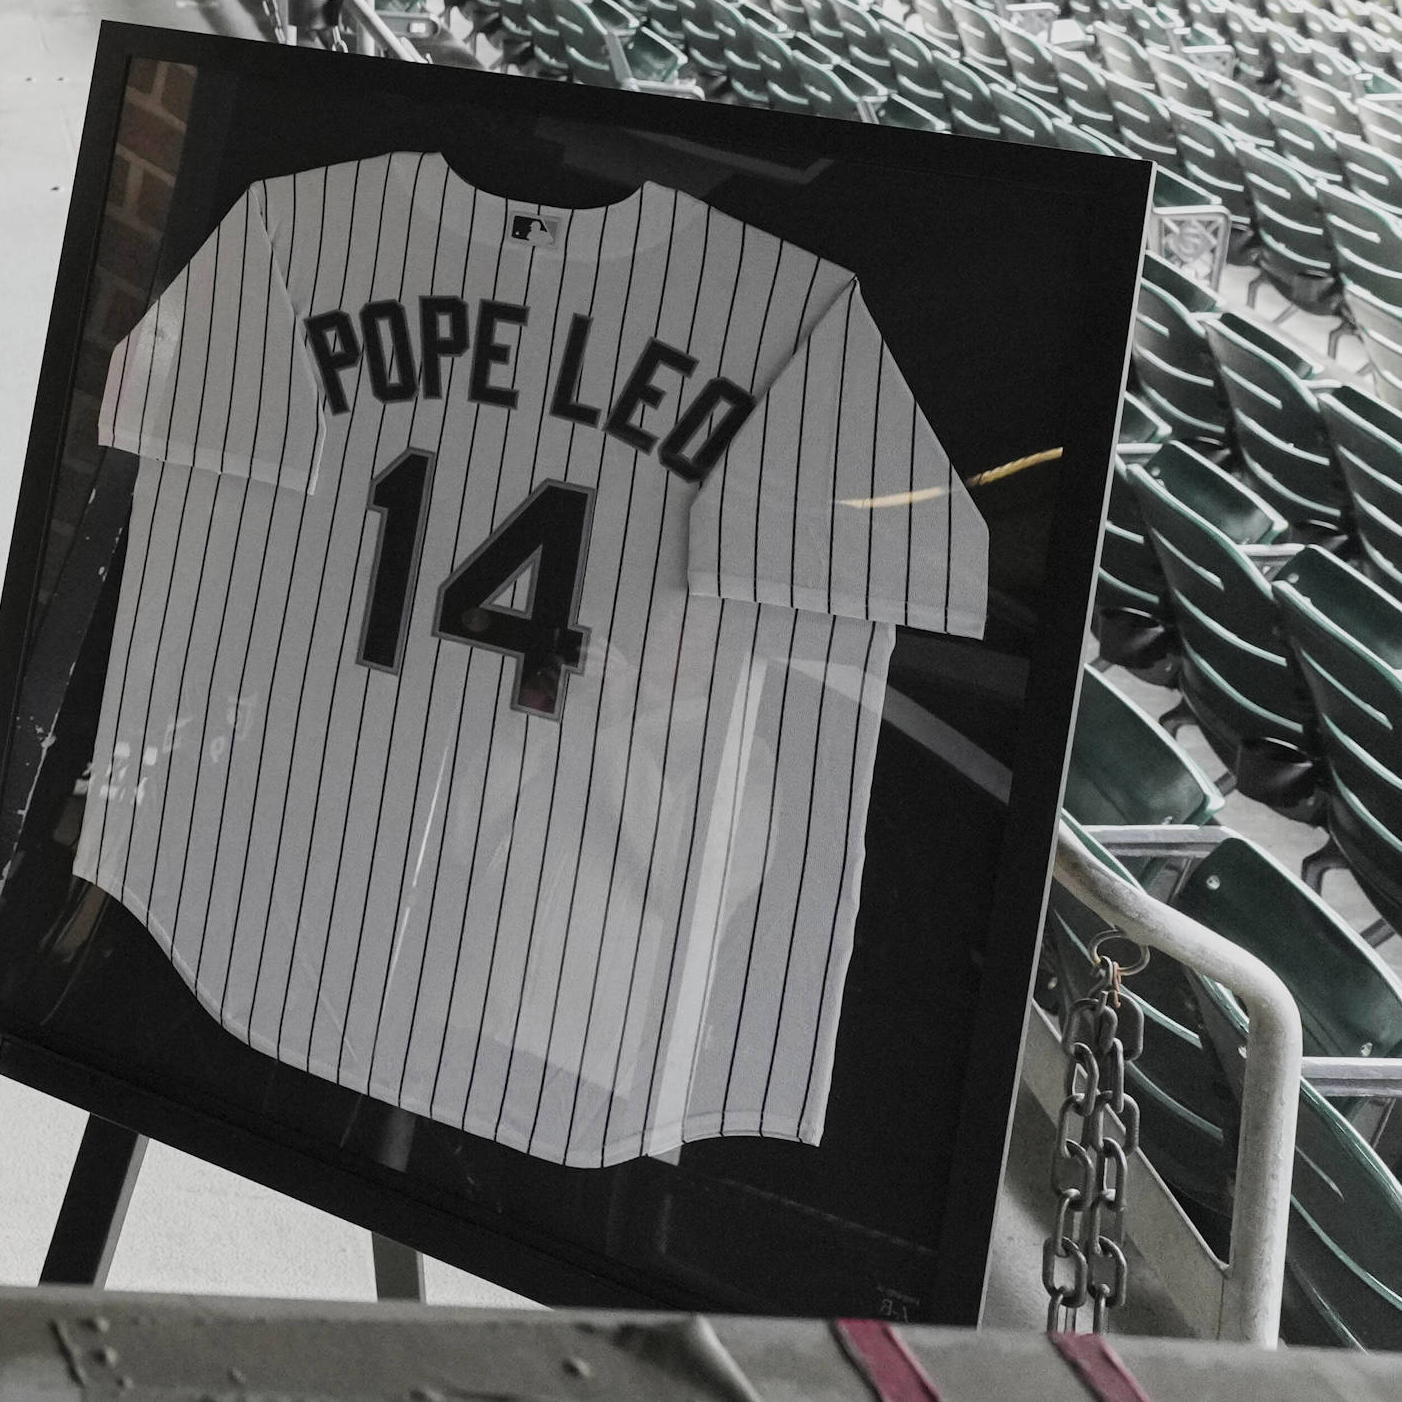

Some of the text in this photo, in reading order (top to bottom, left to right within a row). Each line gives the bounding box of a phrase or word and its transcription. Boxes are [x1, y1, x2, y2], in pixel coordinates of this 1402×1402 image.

[302, 294, 758, 485] POPE LEO
[353, 445, 597, 723] 14
